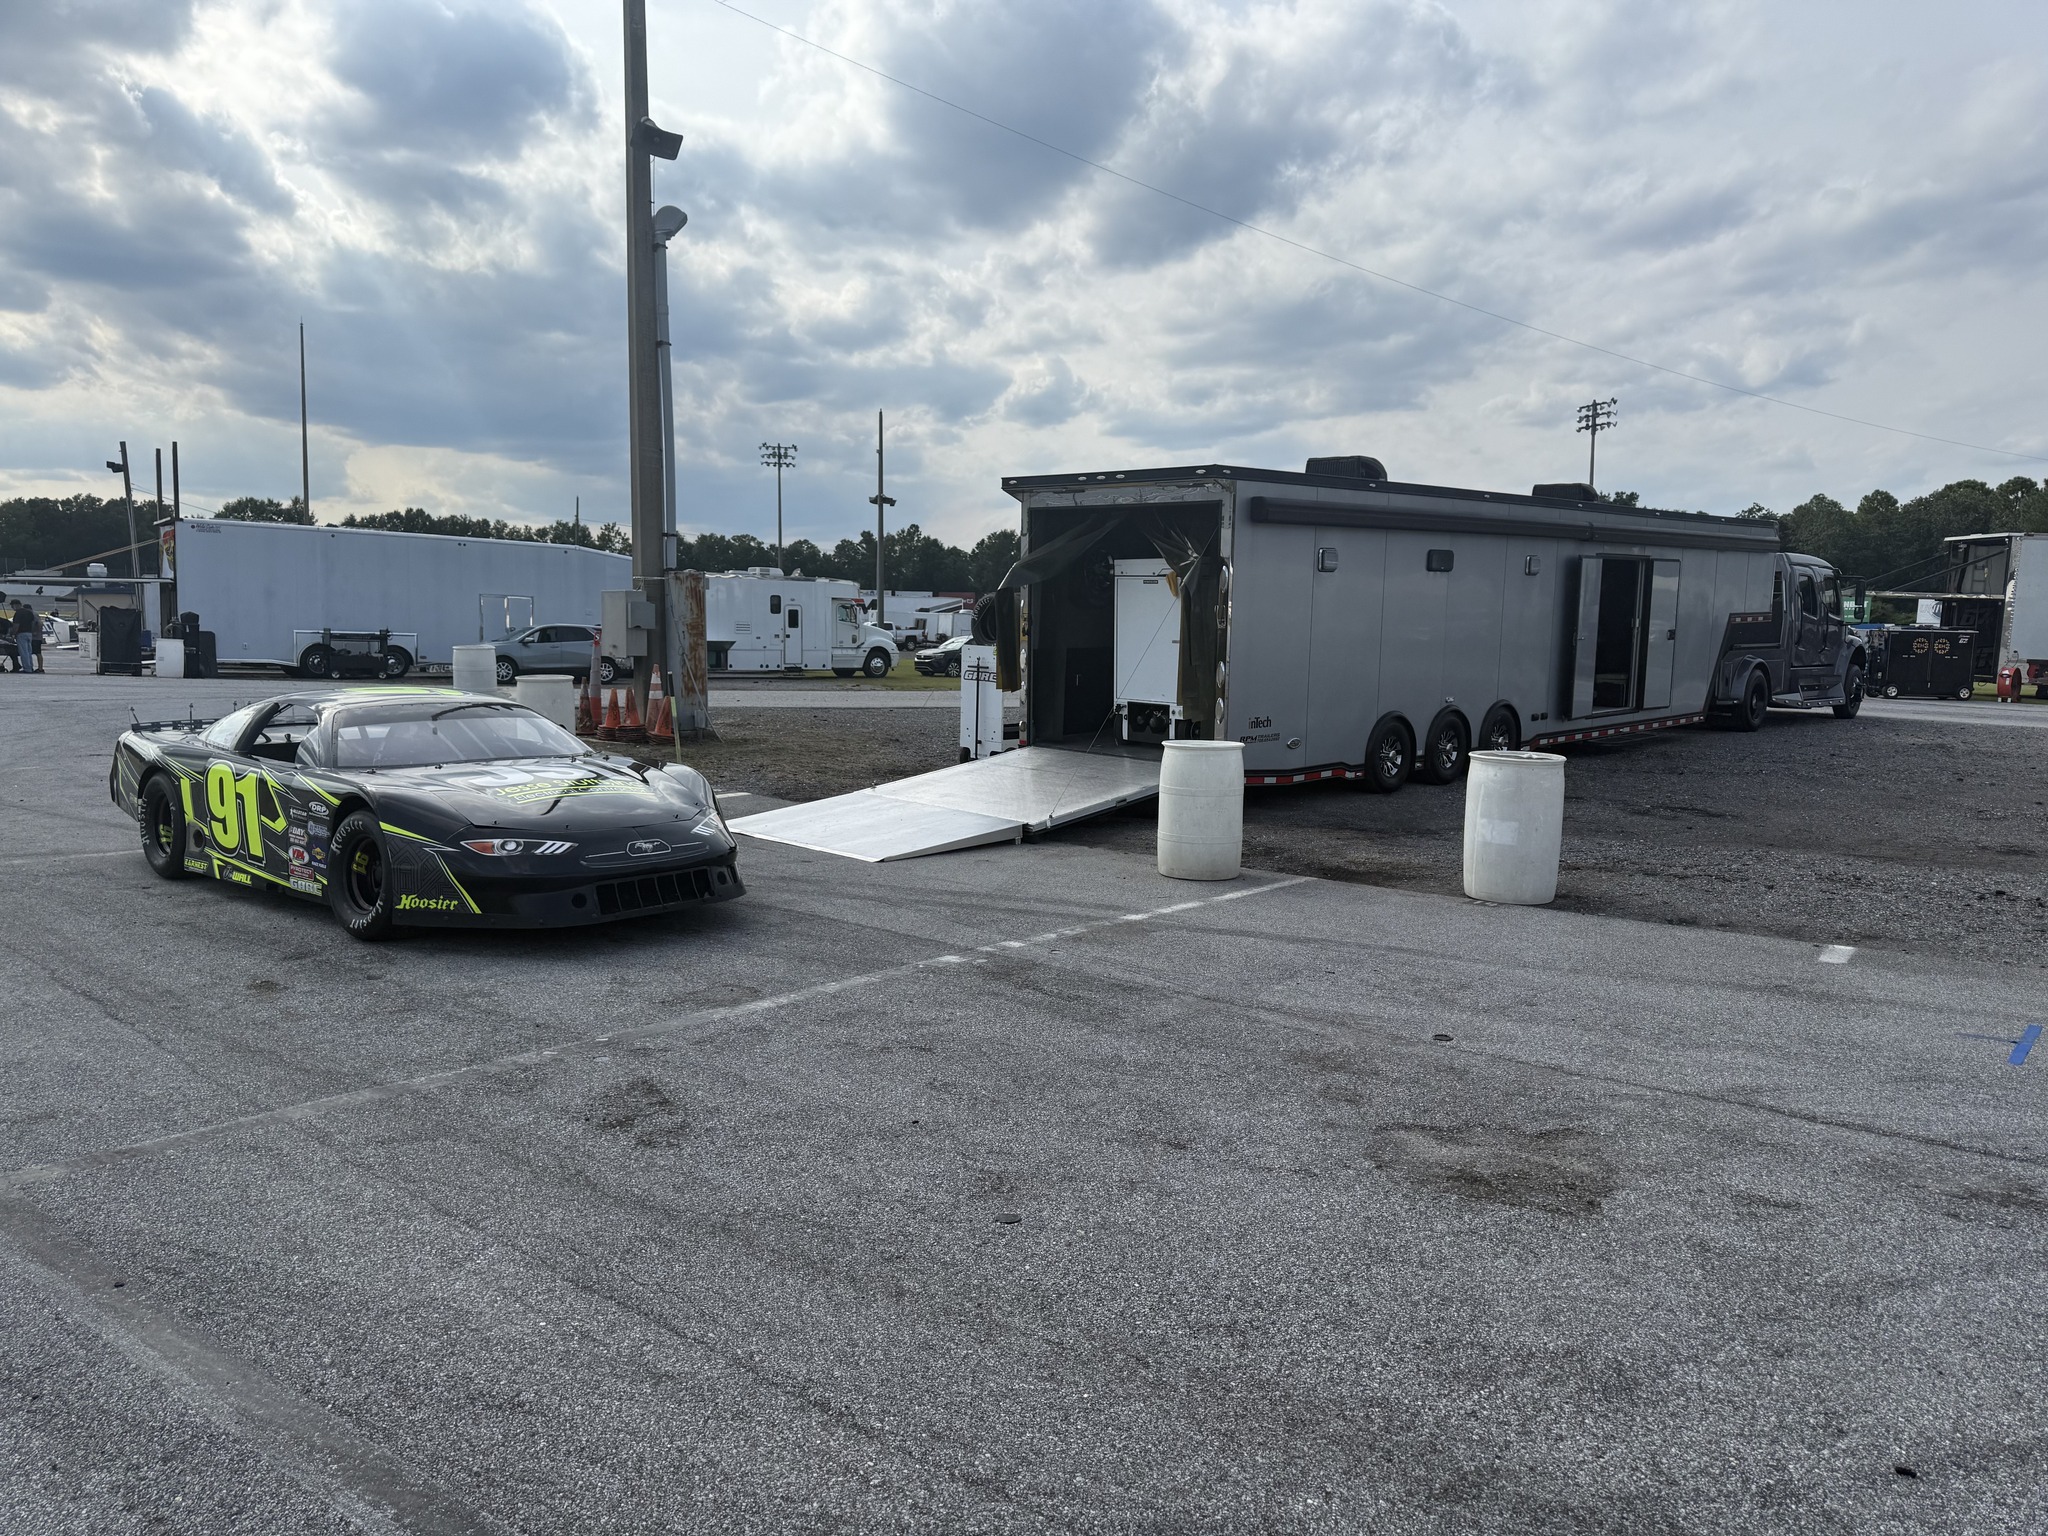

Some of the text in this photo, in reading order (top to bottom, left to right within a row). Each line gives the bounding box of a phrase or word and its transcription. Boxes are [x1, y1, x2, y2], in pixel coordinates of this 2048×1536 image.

[36, 586, 43, 595] 4
[1248, 716, 1272, 729] inTech
[1240, 735, 1257, 743] RPM
[495, 782, 552, 796] Jesse
[206, 762, 264, 860] 91
[312, 804, 327, 813] DRP
[331, 818, 363, 855] Hoosier
[395, 893, 459, 911] Hoosier
